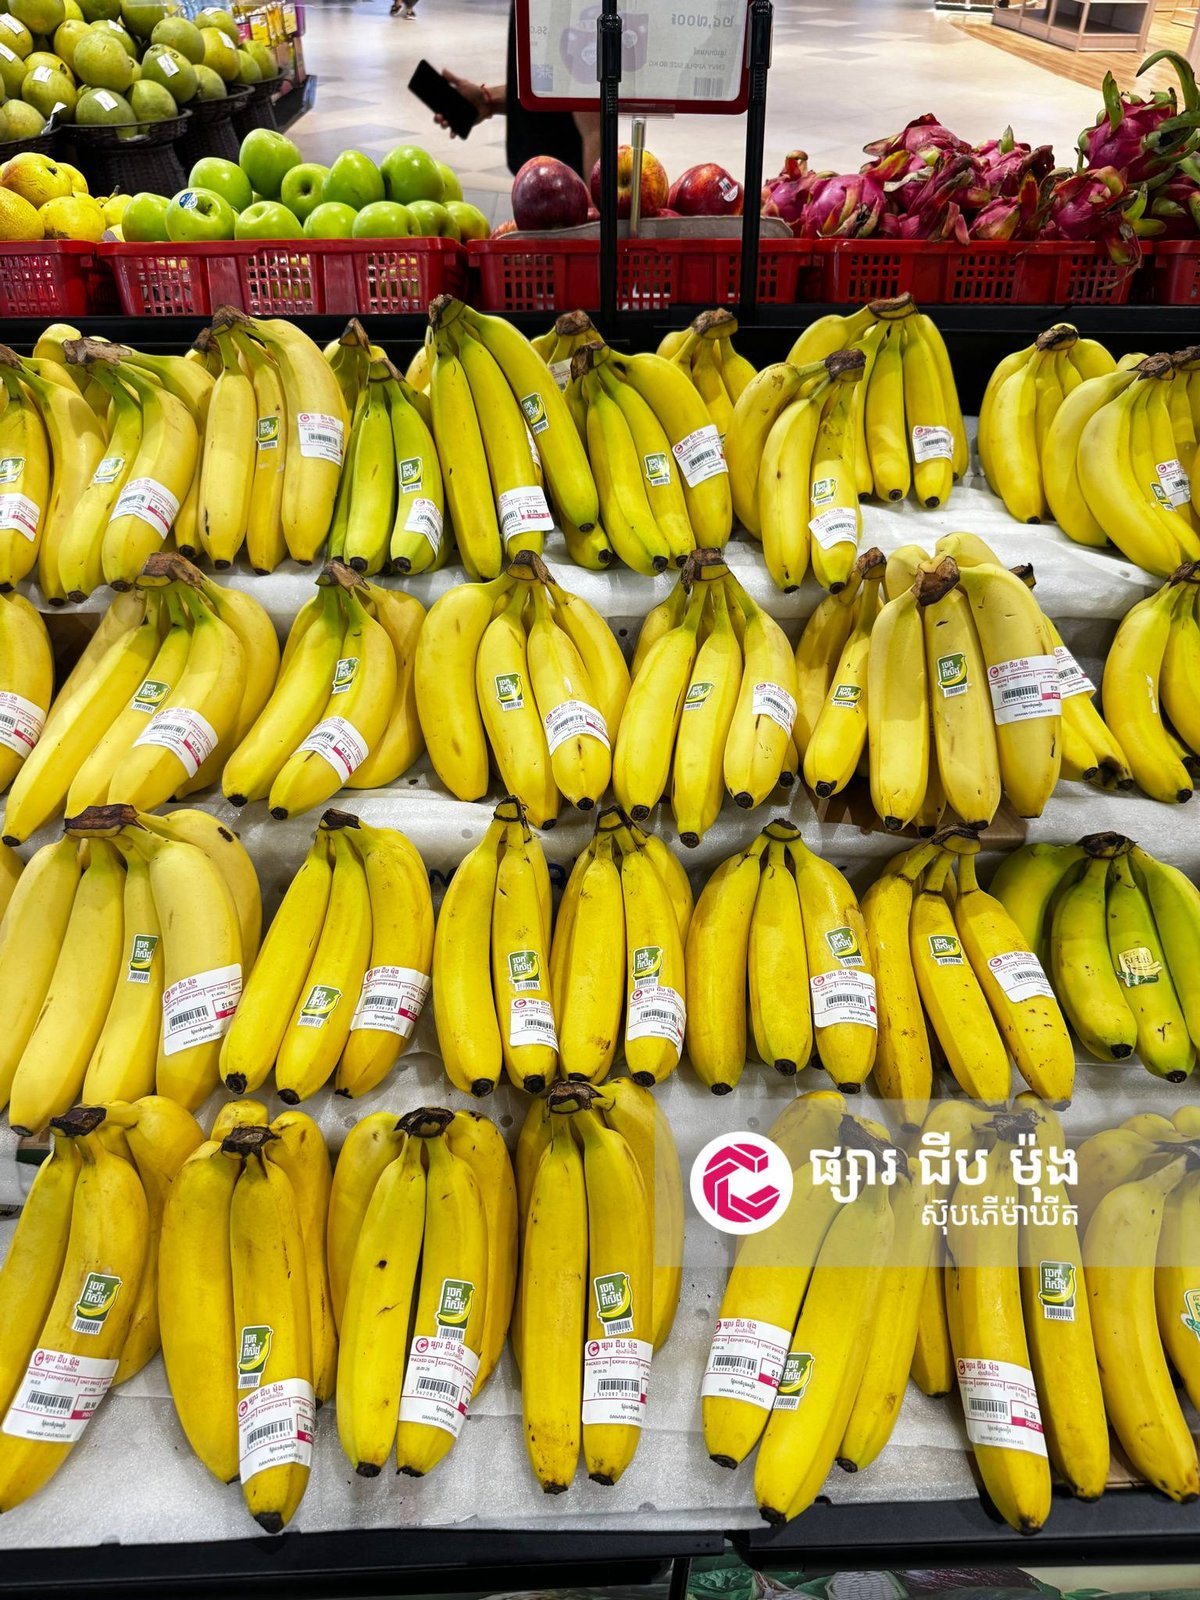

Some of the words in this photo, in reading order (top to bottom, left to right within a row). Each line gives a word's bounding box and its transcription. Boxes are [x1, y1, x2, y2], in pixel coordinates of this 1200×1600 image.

[602, 1342, 613, 1351] ផ្សារ
[616, 1340, 626, 1348] ជីប
[628, 1340, 638, 1350] ម៉ុង
[258, 1406, 274, 1414] EXPIRY
[1026, 1420, 1040, 1430] PRICE
[258, 1458, 276, 1466] BANANA
